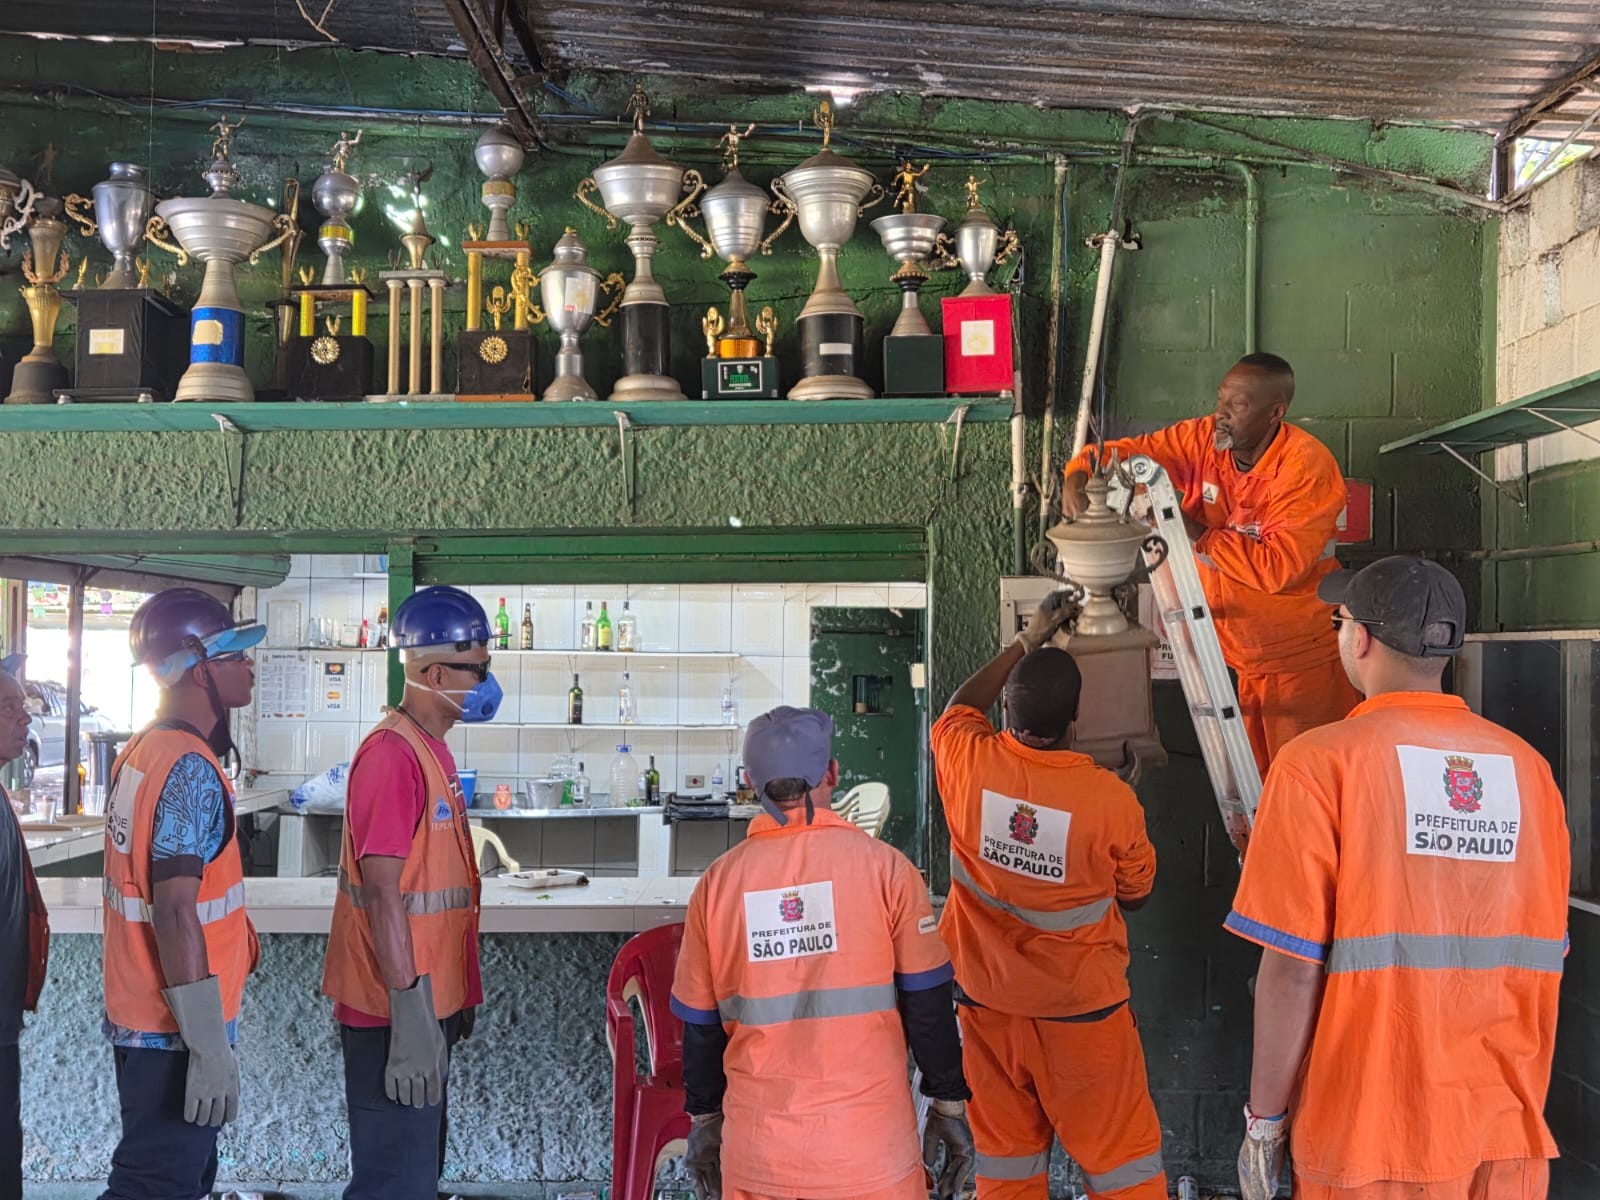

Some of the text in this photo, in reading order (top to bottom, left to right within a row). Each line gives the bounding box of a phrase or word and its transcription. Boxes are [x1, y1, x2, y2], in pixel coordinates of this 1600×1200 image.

[1414, 813, 1518, 834] PREFEITURA DE
[984, 835, 1063, 865] PREFEITURA DE
[1414, 829, 1514, 855] SÃO PAULO
[983, 846, 1063, 878] SÃO PAULO
[751, 921, 832, 938] PREFEITURA DE
[753, 934, 833, 958] SÃO PAULO
